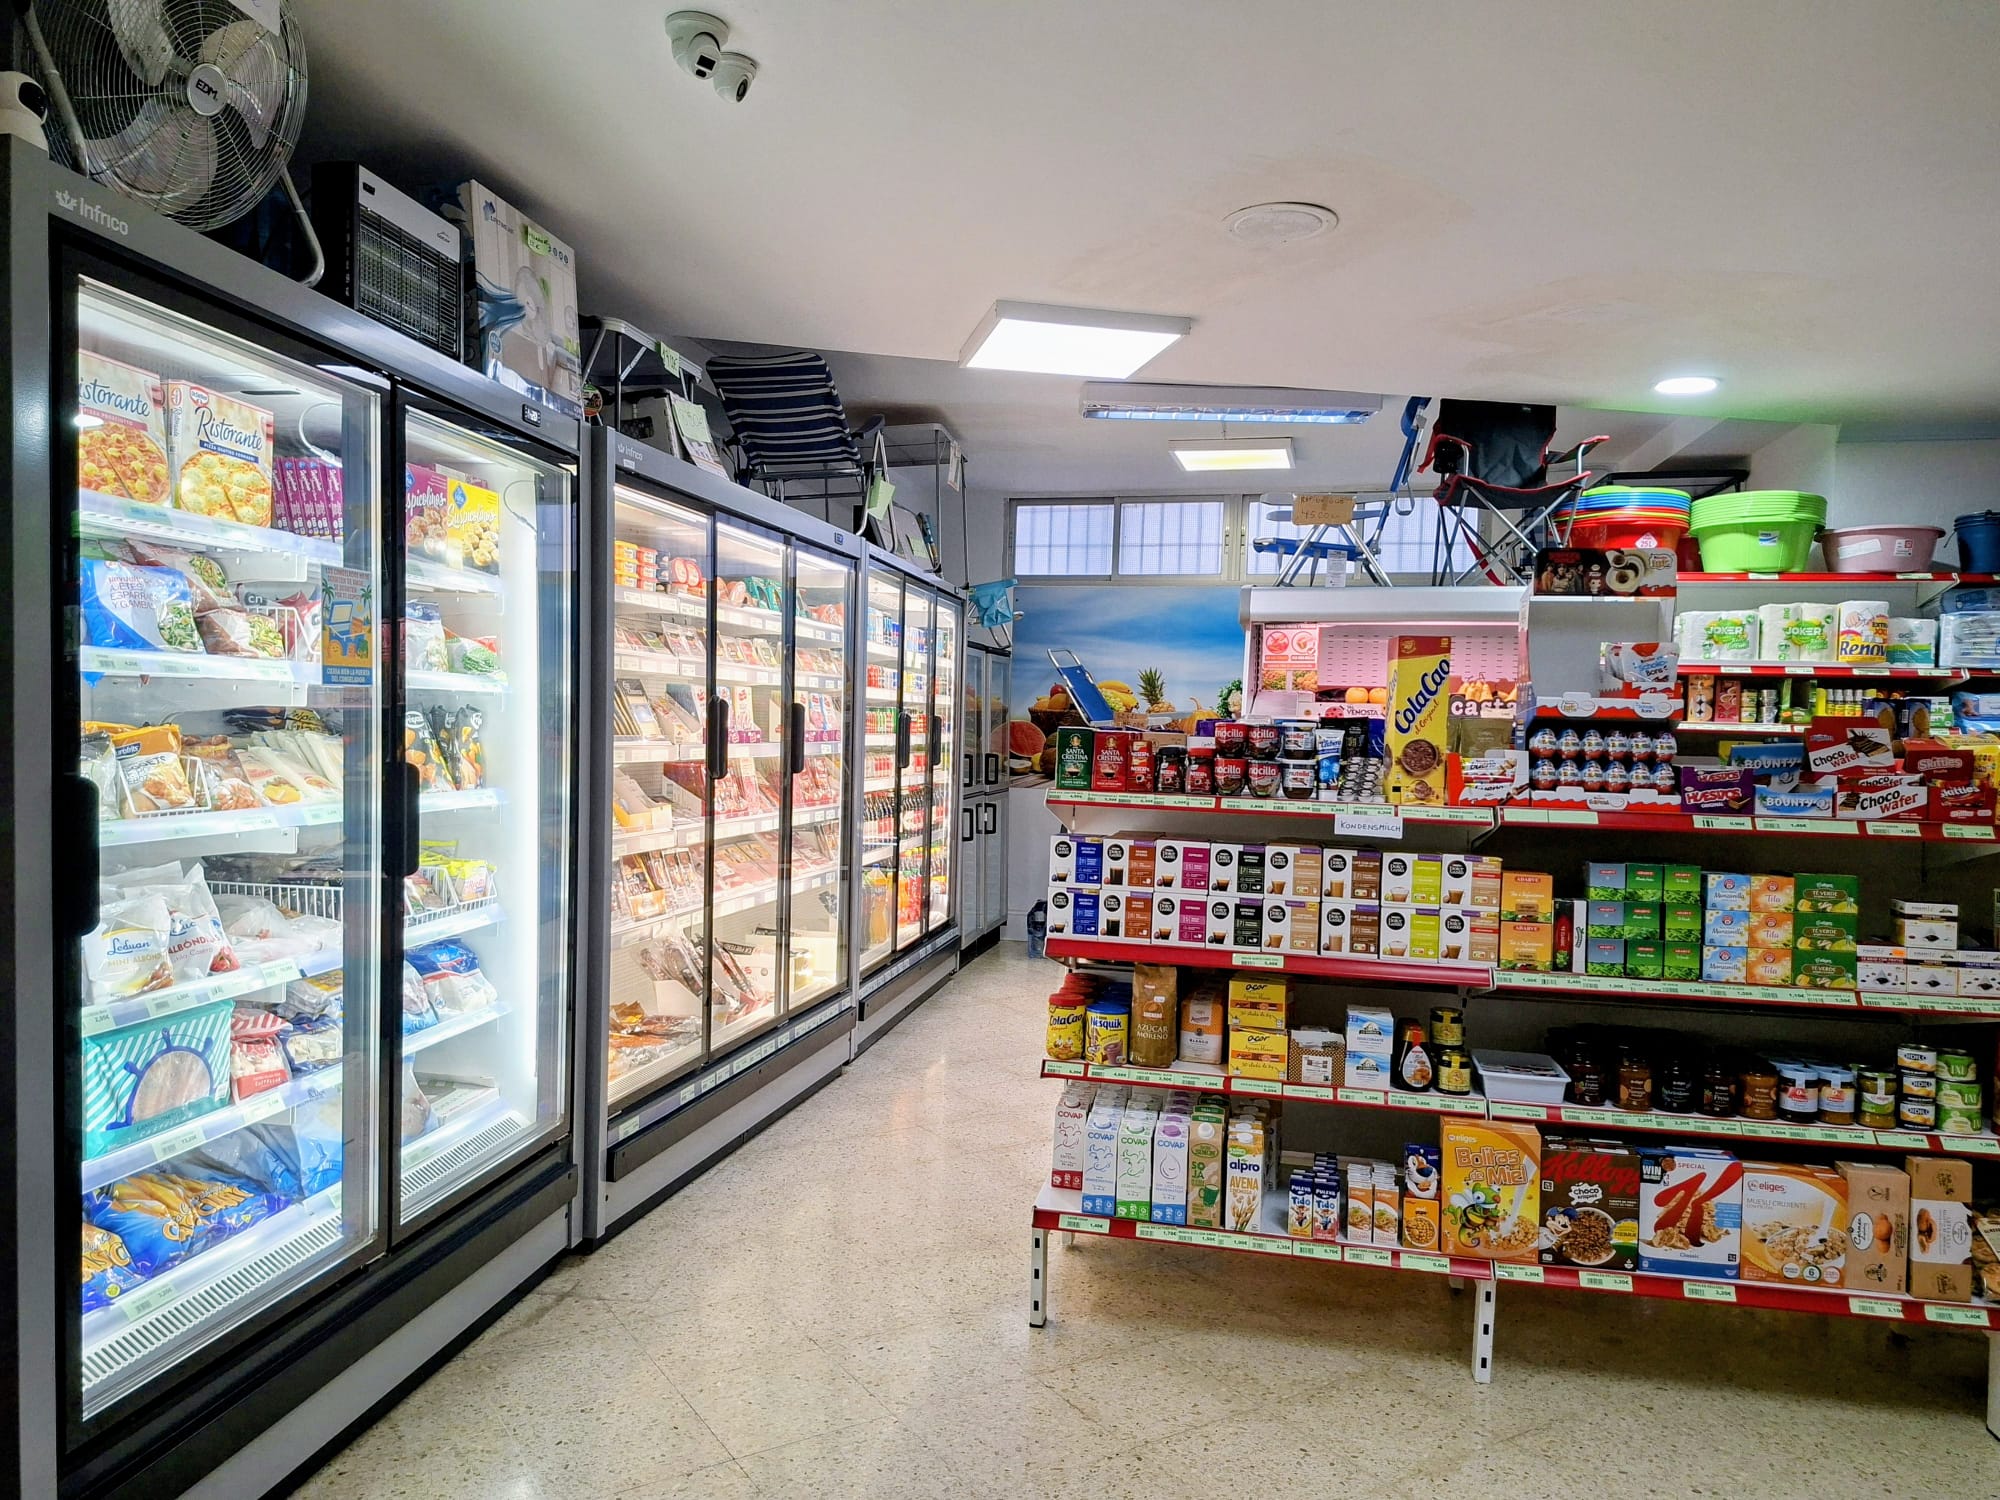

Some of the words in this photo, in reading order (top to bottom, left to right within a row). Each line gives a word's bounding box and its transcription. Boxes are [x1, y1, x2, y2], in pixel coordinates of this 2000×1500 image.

[195, 78, 219, 101] EDM
[79, 197, 129, 236] Infrico
[80, 377, 151, 418] istorante
[194, 406, 262, 452] Ristorante
[405, 485, 447, 515] spicolinos
[1705, 625, 1744, 635] JOKER
[1784, 625, 1823, 636] JOKER
[1840, 640, 1887, 656] Renov
[1394, 658, 1451, 735] ColaCao
[1061, 753, 1088, 761] CRISTINA
[1096, 754, 1124, 763] CRISTINA
[1100, 749, 1120, 757] SANTA
[1812, 750, 1845, 767] Choco
[1744, 759, 1799, 769] BOUNTY
[1830, 751, 1861, 768] wafer
[1684, 788, 1742, 804] HUESITOS
[1860, 790, 1901, 811] Choco
[1766, 797, 1814, 807] BOUNTY
[1880, 791, 1919, 814] wafer
[1340, 819, 1401, 832] KONDENSMILCH
[1766, 894, 1781, 904] Tila
[1764, 930, 1779, 939] Tila
[1761, 966, 1777, 975] Tila
[1049, 1013, 1082, 1026] ColaCao
[1090, 1016, 1122, 1028] Nesquik
[1137, 1022, 1168, 1033] AZÚCAR
[1137, 1031, 1168, 1040] MORENO
[1057, 1110, 1083, 1119] COVAP
[1087, 1132, 1115, 1141] COVAP
[1120, 1137, 1148, 1146] COVAP
[1157, 1140, 1185, 1149] COVAP
[1455, 1146, 1520, 1168] Bolitas
[1229, 1159, 1260, 1173] alpro
[1642, 1165, 1662, 1175] WIN
[1677, 1161, 1706, 1170] SPECIAL
[1486, 1166, 1528, 1186] Miel
[1229, 1175, 1259, 1191] AVENA
[1759, 1180, 1785, 1193] eliges
[1573, 1187, 1599, 1195] choco
[1291, 1196, 1311, 1206] Tido
[1315, 1200, 1335, 1210] Tido
